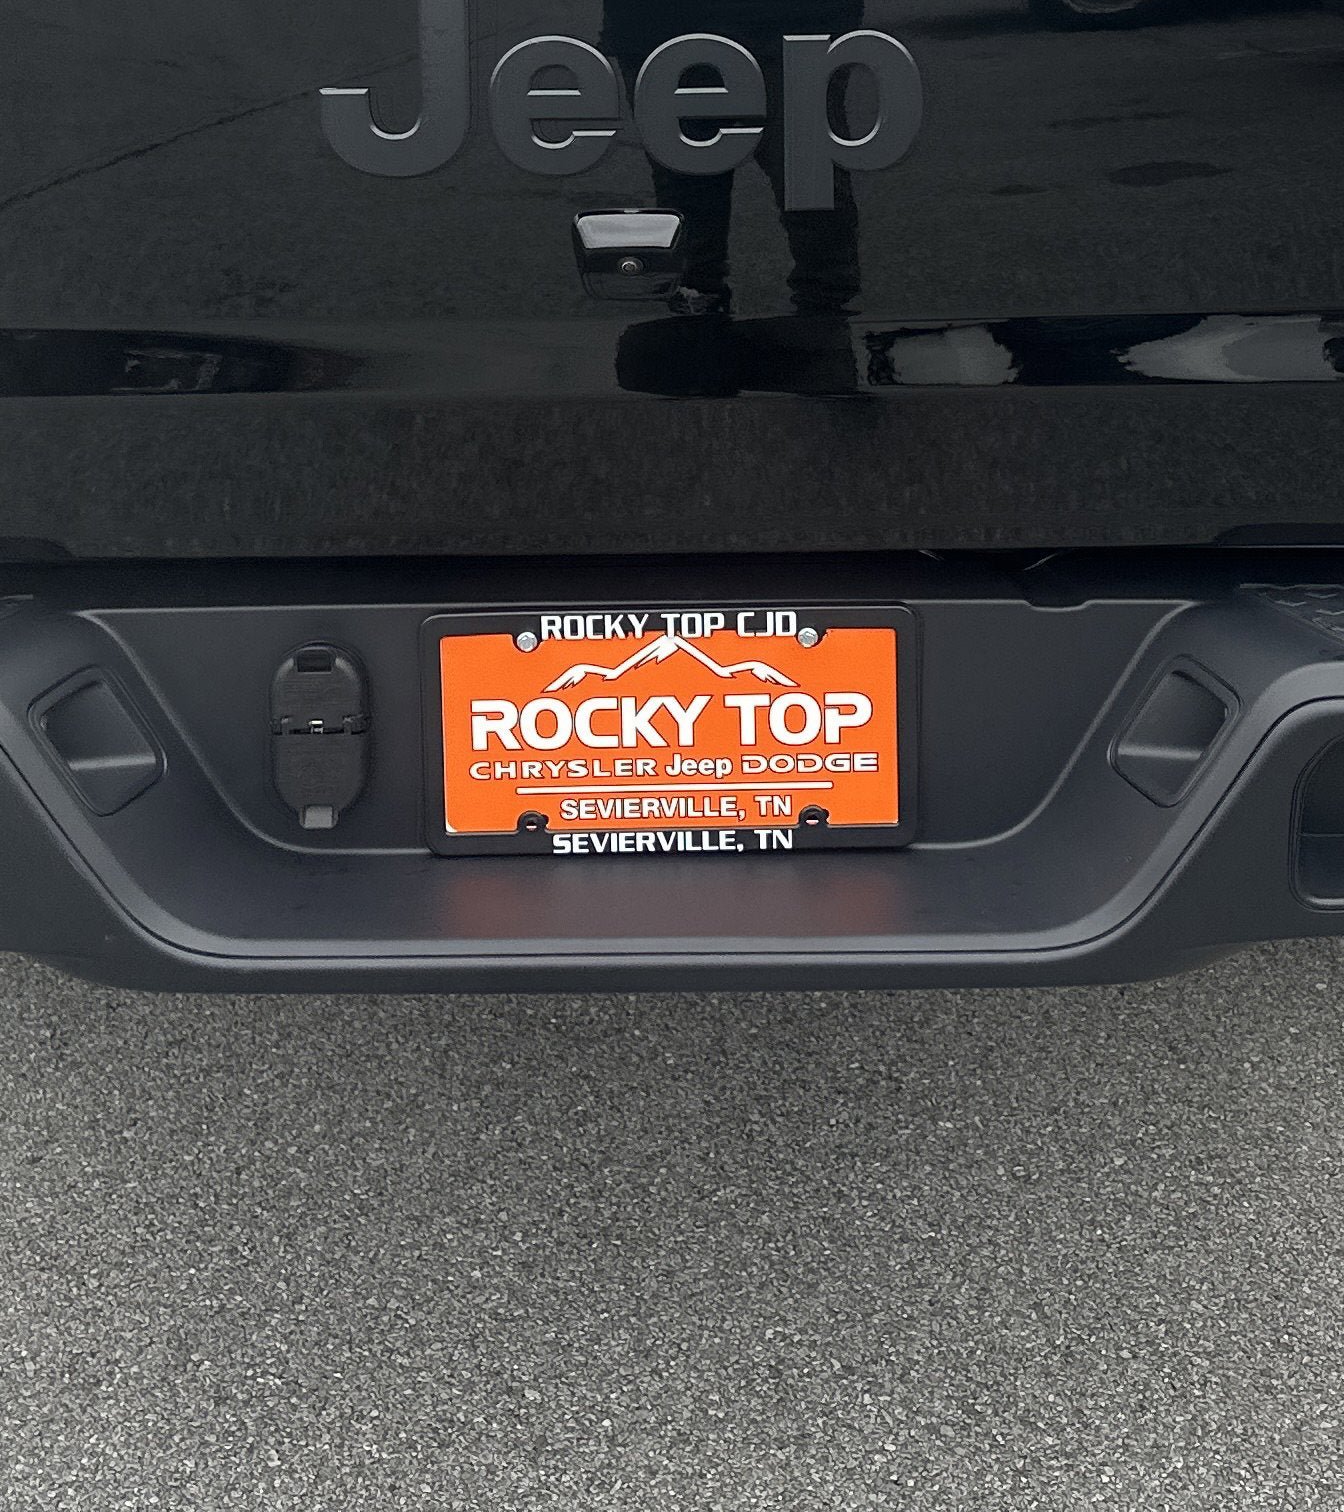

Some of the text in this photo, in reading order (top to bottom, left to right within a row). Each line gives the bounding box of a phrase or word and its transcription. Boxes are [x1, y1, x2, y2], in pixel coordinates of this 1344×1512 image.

[540, 611, 798, 641] ROCKY TOP CJD
[470, 691, 874, 752] ROCKY TOP
[469, 752, 879, 780] CHRYSLER Jeep DODGE
[560, 795, 793, 821] SEVIERVILLE, TN
[552, 828, 794, 854] SEVIERVILLE, TN
